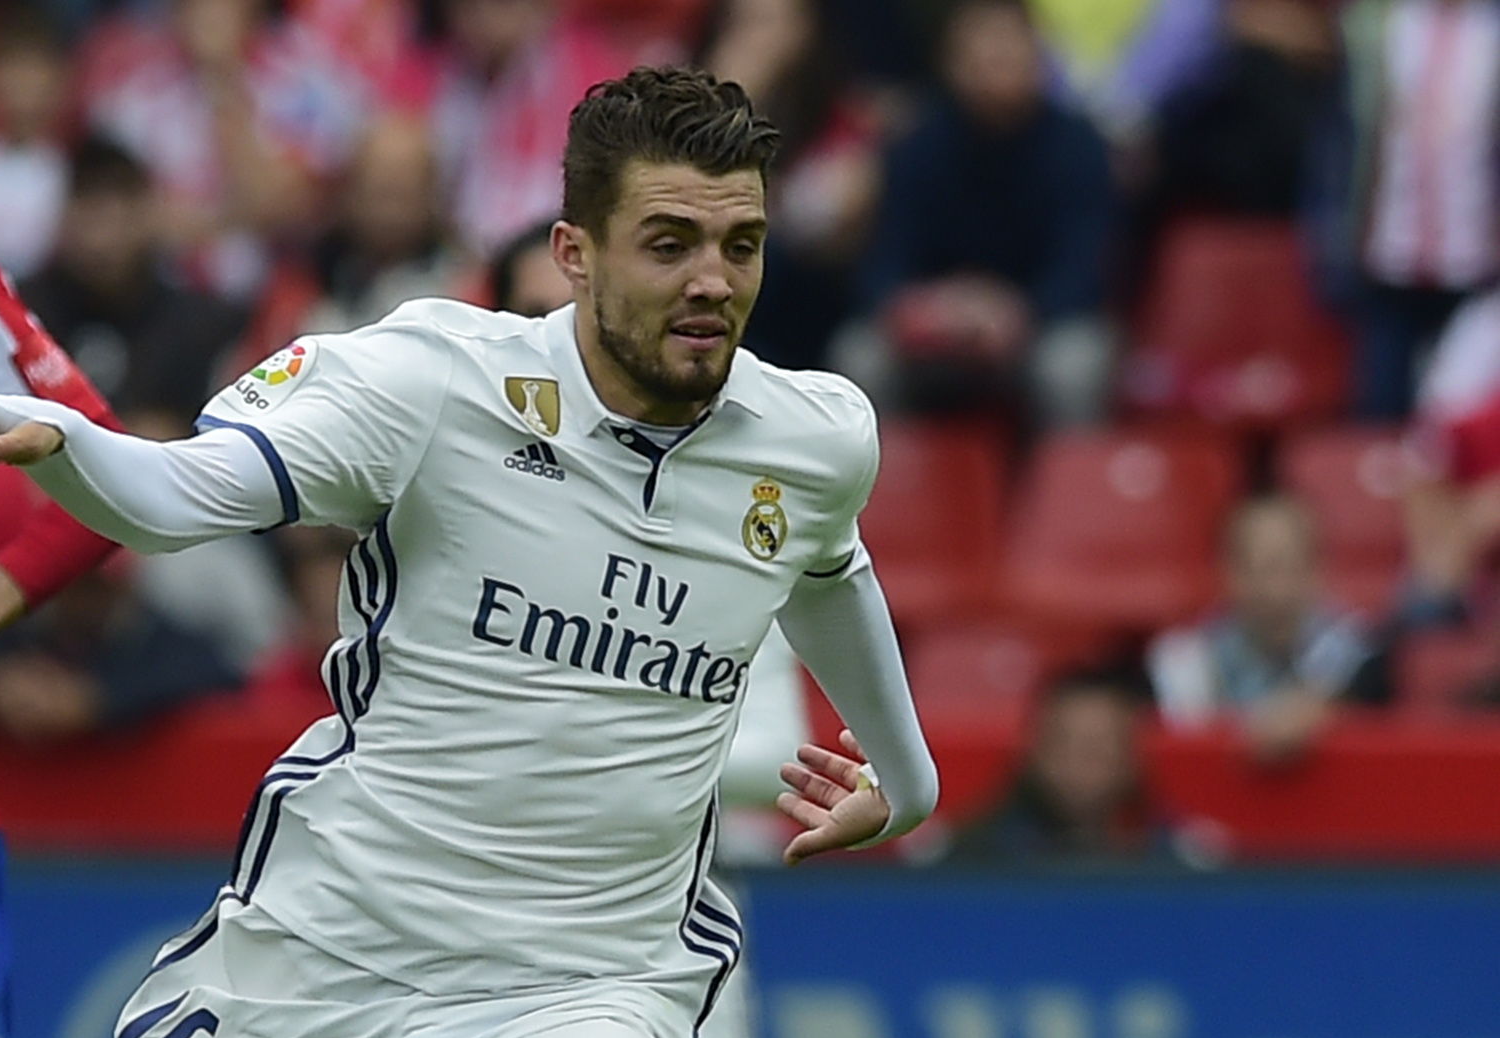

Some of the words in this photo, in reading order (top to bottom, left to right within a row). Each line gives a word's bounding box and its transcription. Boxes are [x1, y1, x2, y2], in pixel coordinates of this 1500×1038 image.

[503, 456, 566, 482] adidas
[601, 553, 689, 626] Fly
[472, 576, 749, 703] Emirates
